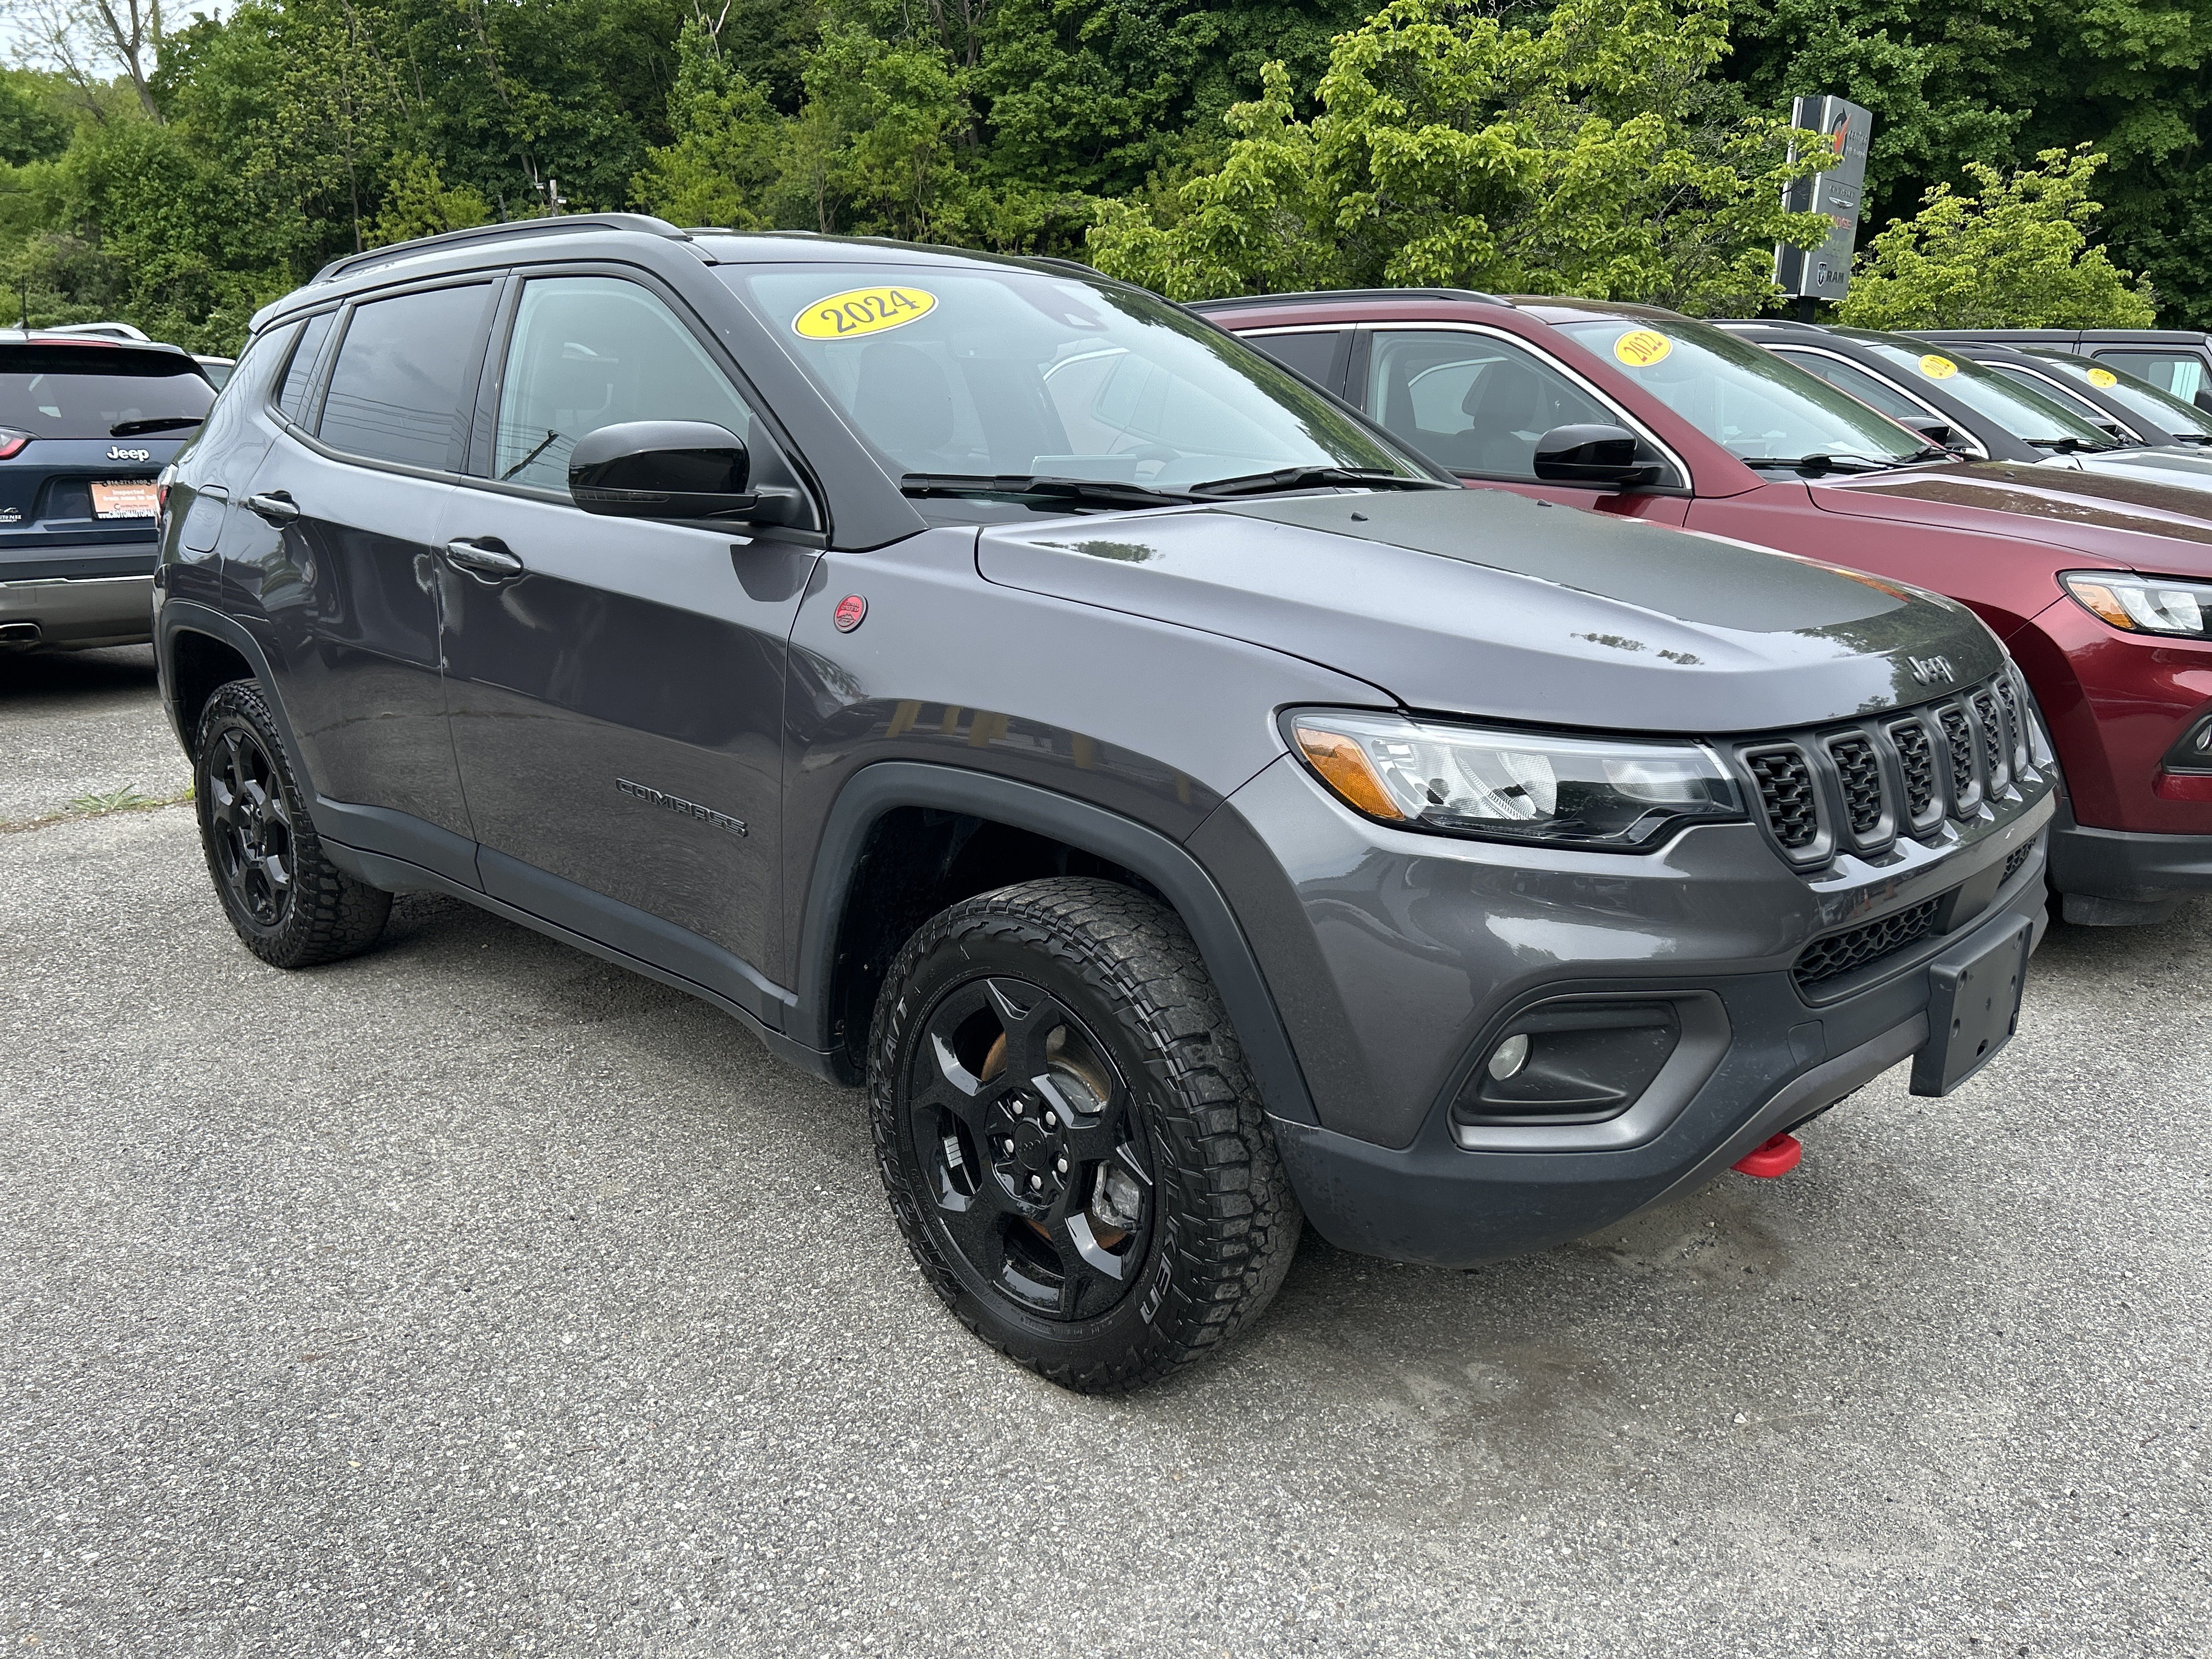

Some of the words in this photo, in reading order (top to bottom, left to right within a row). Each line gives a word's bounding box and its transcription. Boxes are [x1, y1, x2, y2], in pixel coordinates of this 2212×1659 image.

[1826, 270, 1844, 284] RAM
[820, 290, 921, 334] 2024
[1623, 332, 1663, 363] 2022
[1925, 357, 1950, 376] 2022
[106, 446, 149, 462] Jeep
[1906, 655, 1954, 685] Jeep
[615, 777, 748, 838] COMPASS
[881, 1074, 969, 1298] WILDPEAK
[1140, 1091, 1181, 1325] FALKEN
